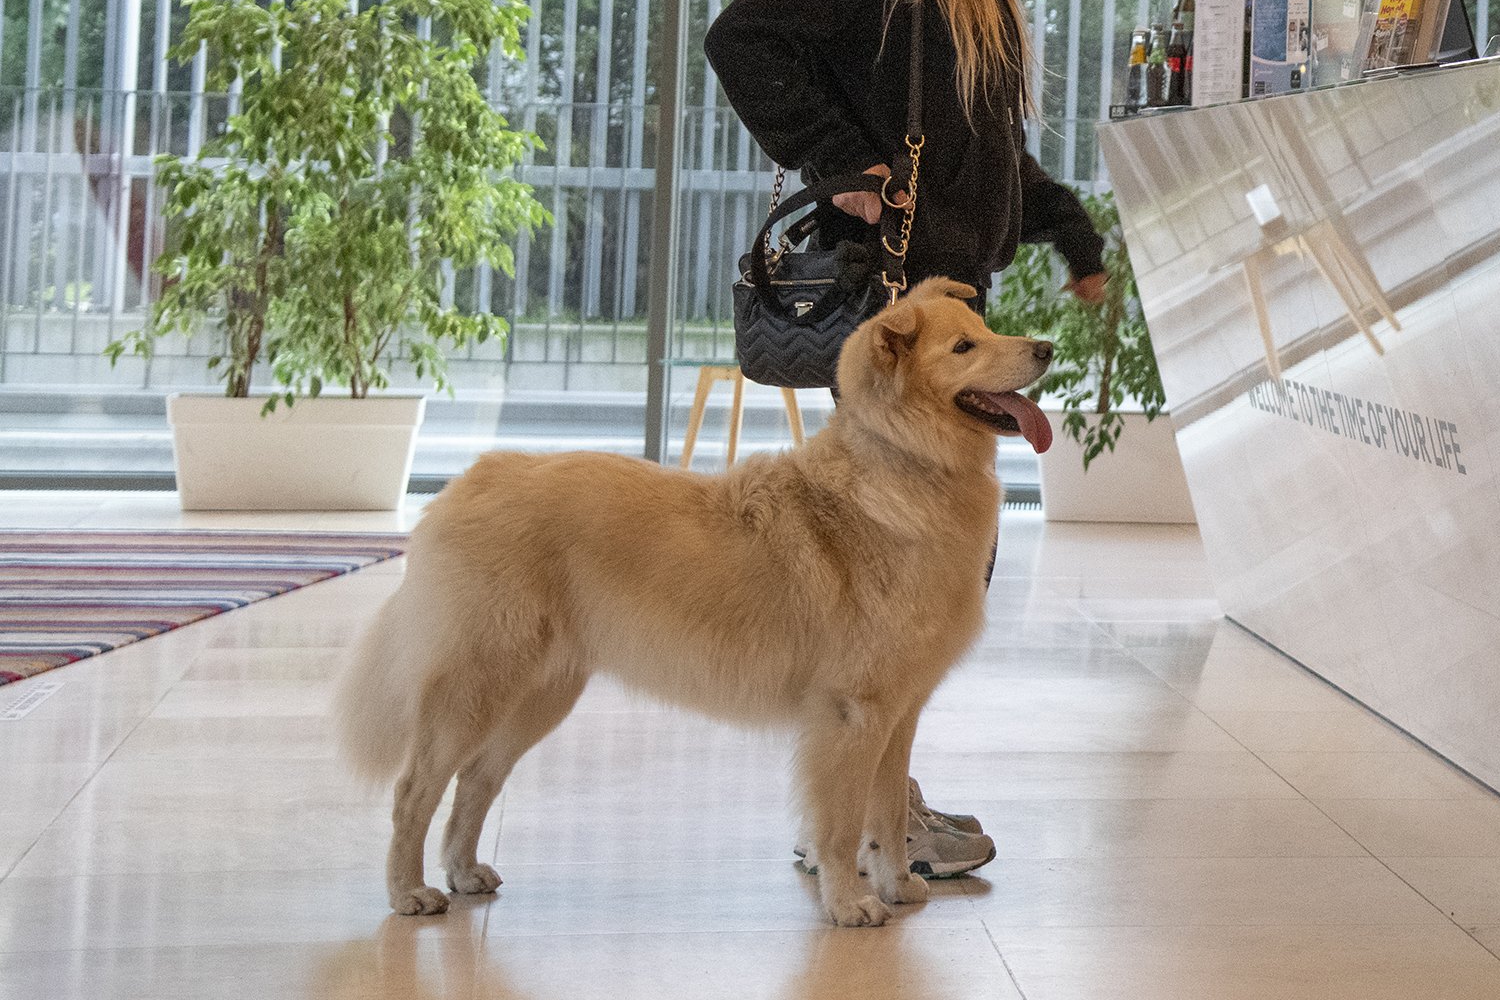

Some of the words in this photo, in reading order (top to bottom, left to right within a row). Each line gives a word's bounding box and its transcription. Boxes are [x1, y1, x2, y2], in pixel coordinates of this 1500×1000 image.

[1248, 378, 1299, 421] WELCOME
[1293, 381, 1314, 427] TO
[1309, 386, 1340, 435] THE
[1333, 393, 1371, 445] TIME
[1367, 401, 1387, 450] OF
[1384, 405, 1432, 464] YOUR
[1425, 416, 1467, 475] LIFE
